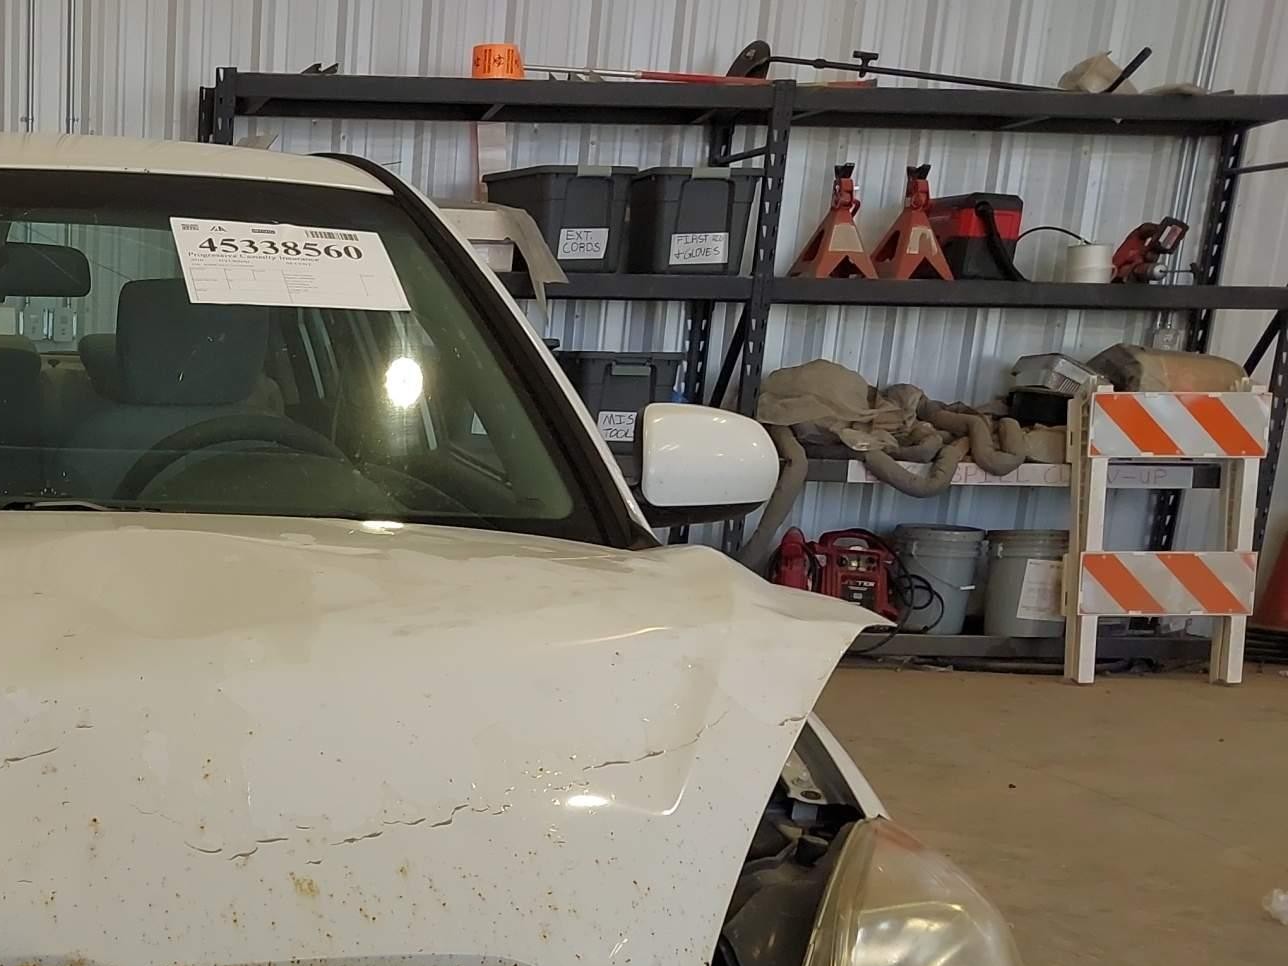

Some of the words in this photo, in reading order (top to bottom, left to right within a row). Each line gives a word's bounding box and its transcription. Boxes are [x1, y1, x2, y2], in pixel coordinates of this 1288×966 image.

[566, 230, 593, 241] EXT.
[198, 237, 363, 260] 45338560
[562, 241, 601, 254] CORDS
